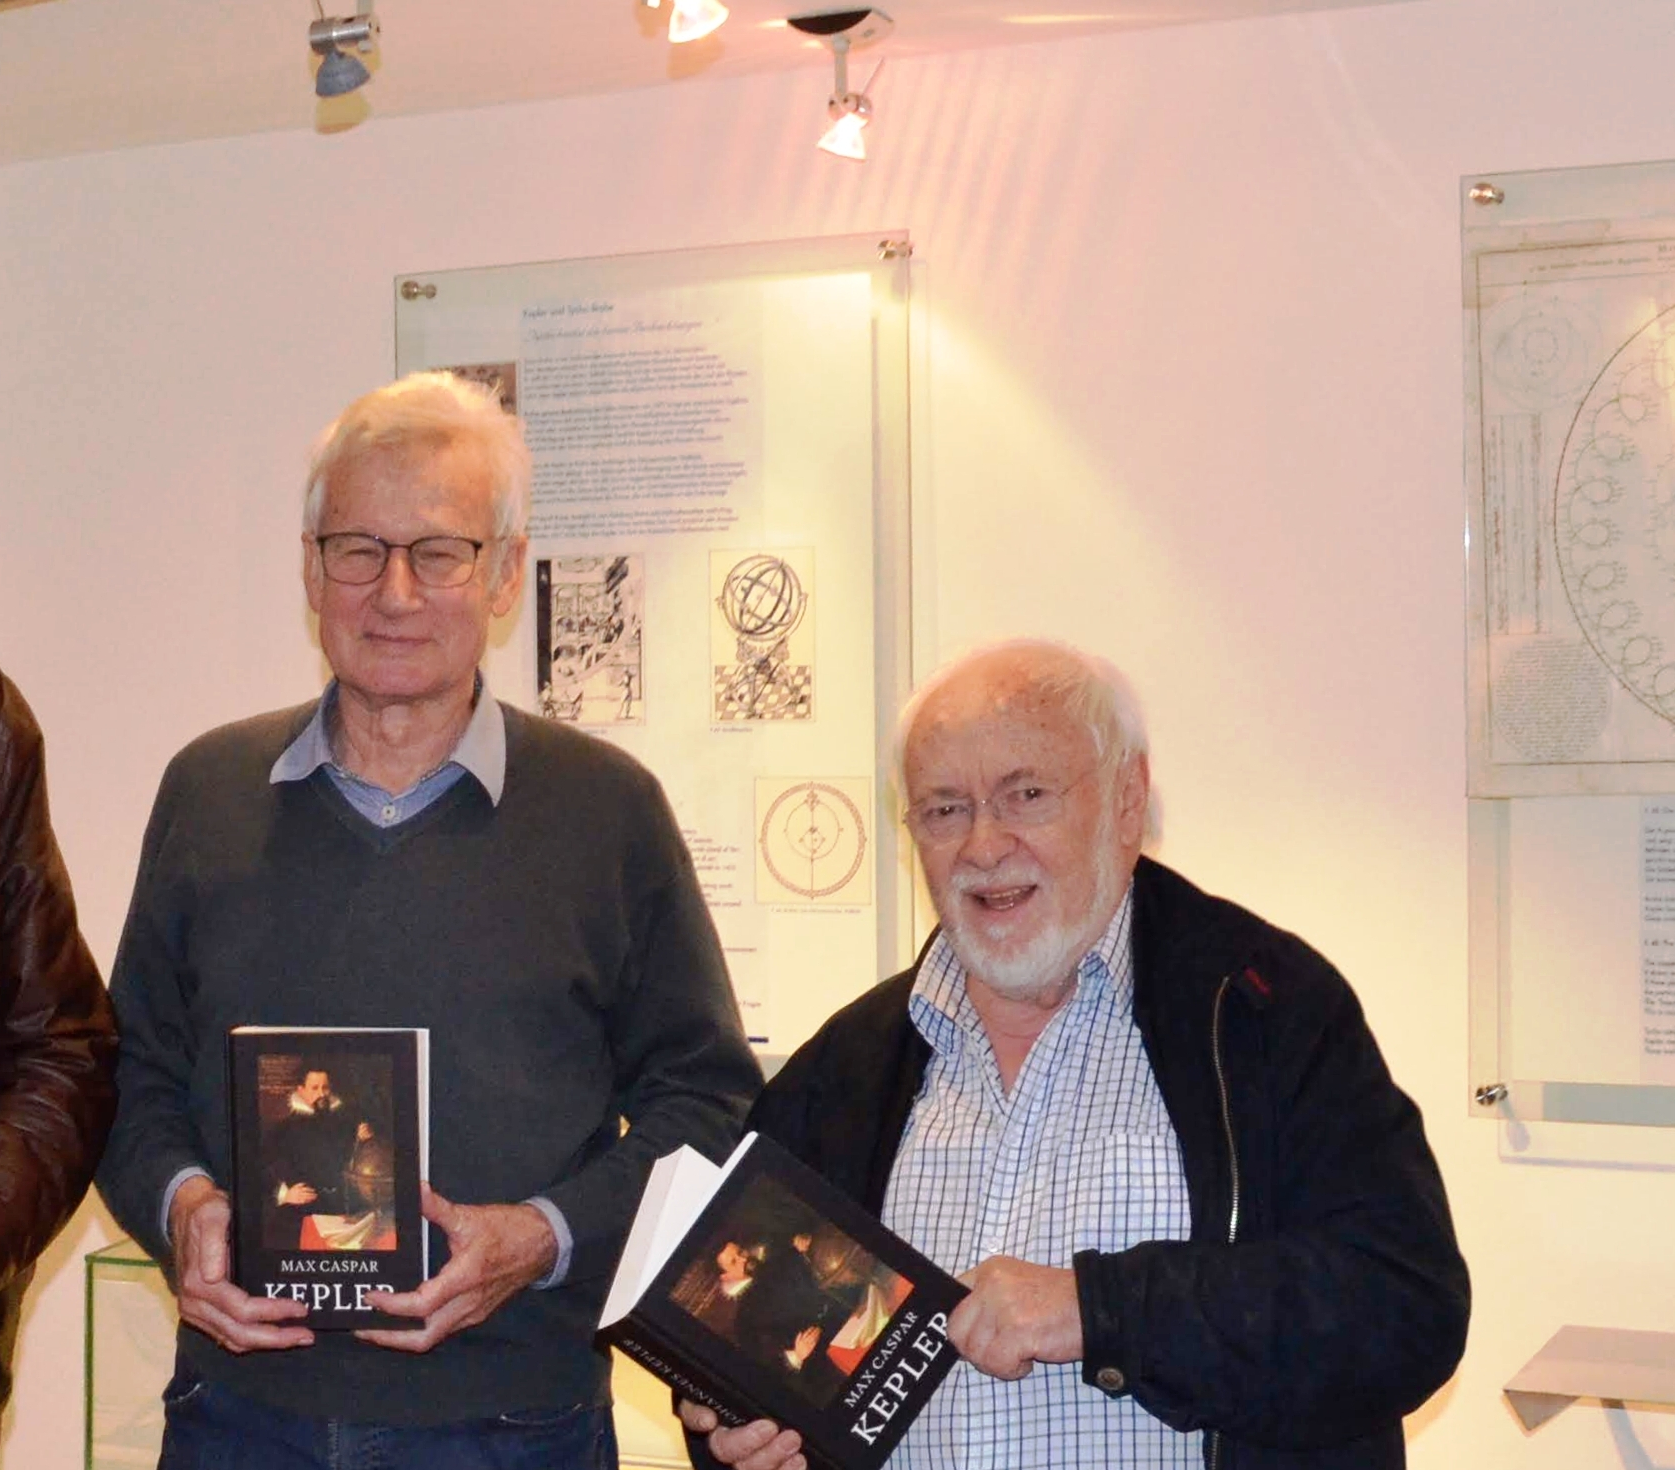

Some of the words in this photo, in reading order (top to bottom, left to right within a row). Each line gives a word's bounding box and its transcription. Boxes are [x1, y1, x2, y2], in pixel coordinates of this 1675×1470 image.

[280, 1260, 316, 1273] MAX
[319, 1260, 379, 1273] CASPAR
[844, 1369, 877, 1408] MAX
[872, 1311, 919, 1370] CASPAR
